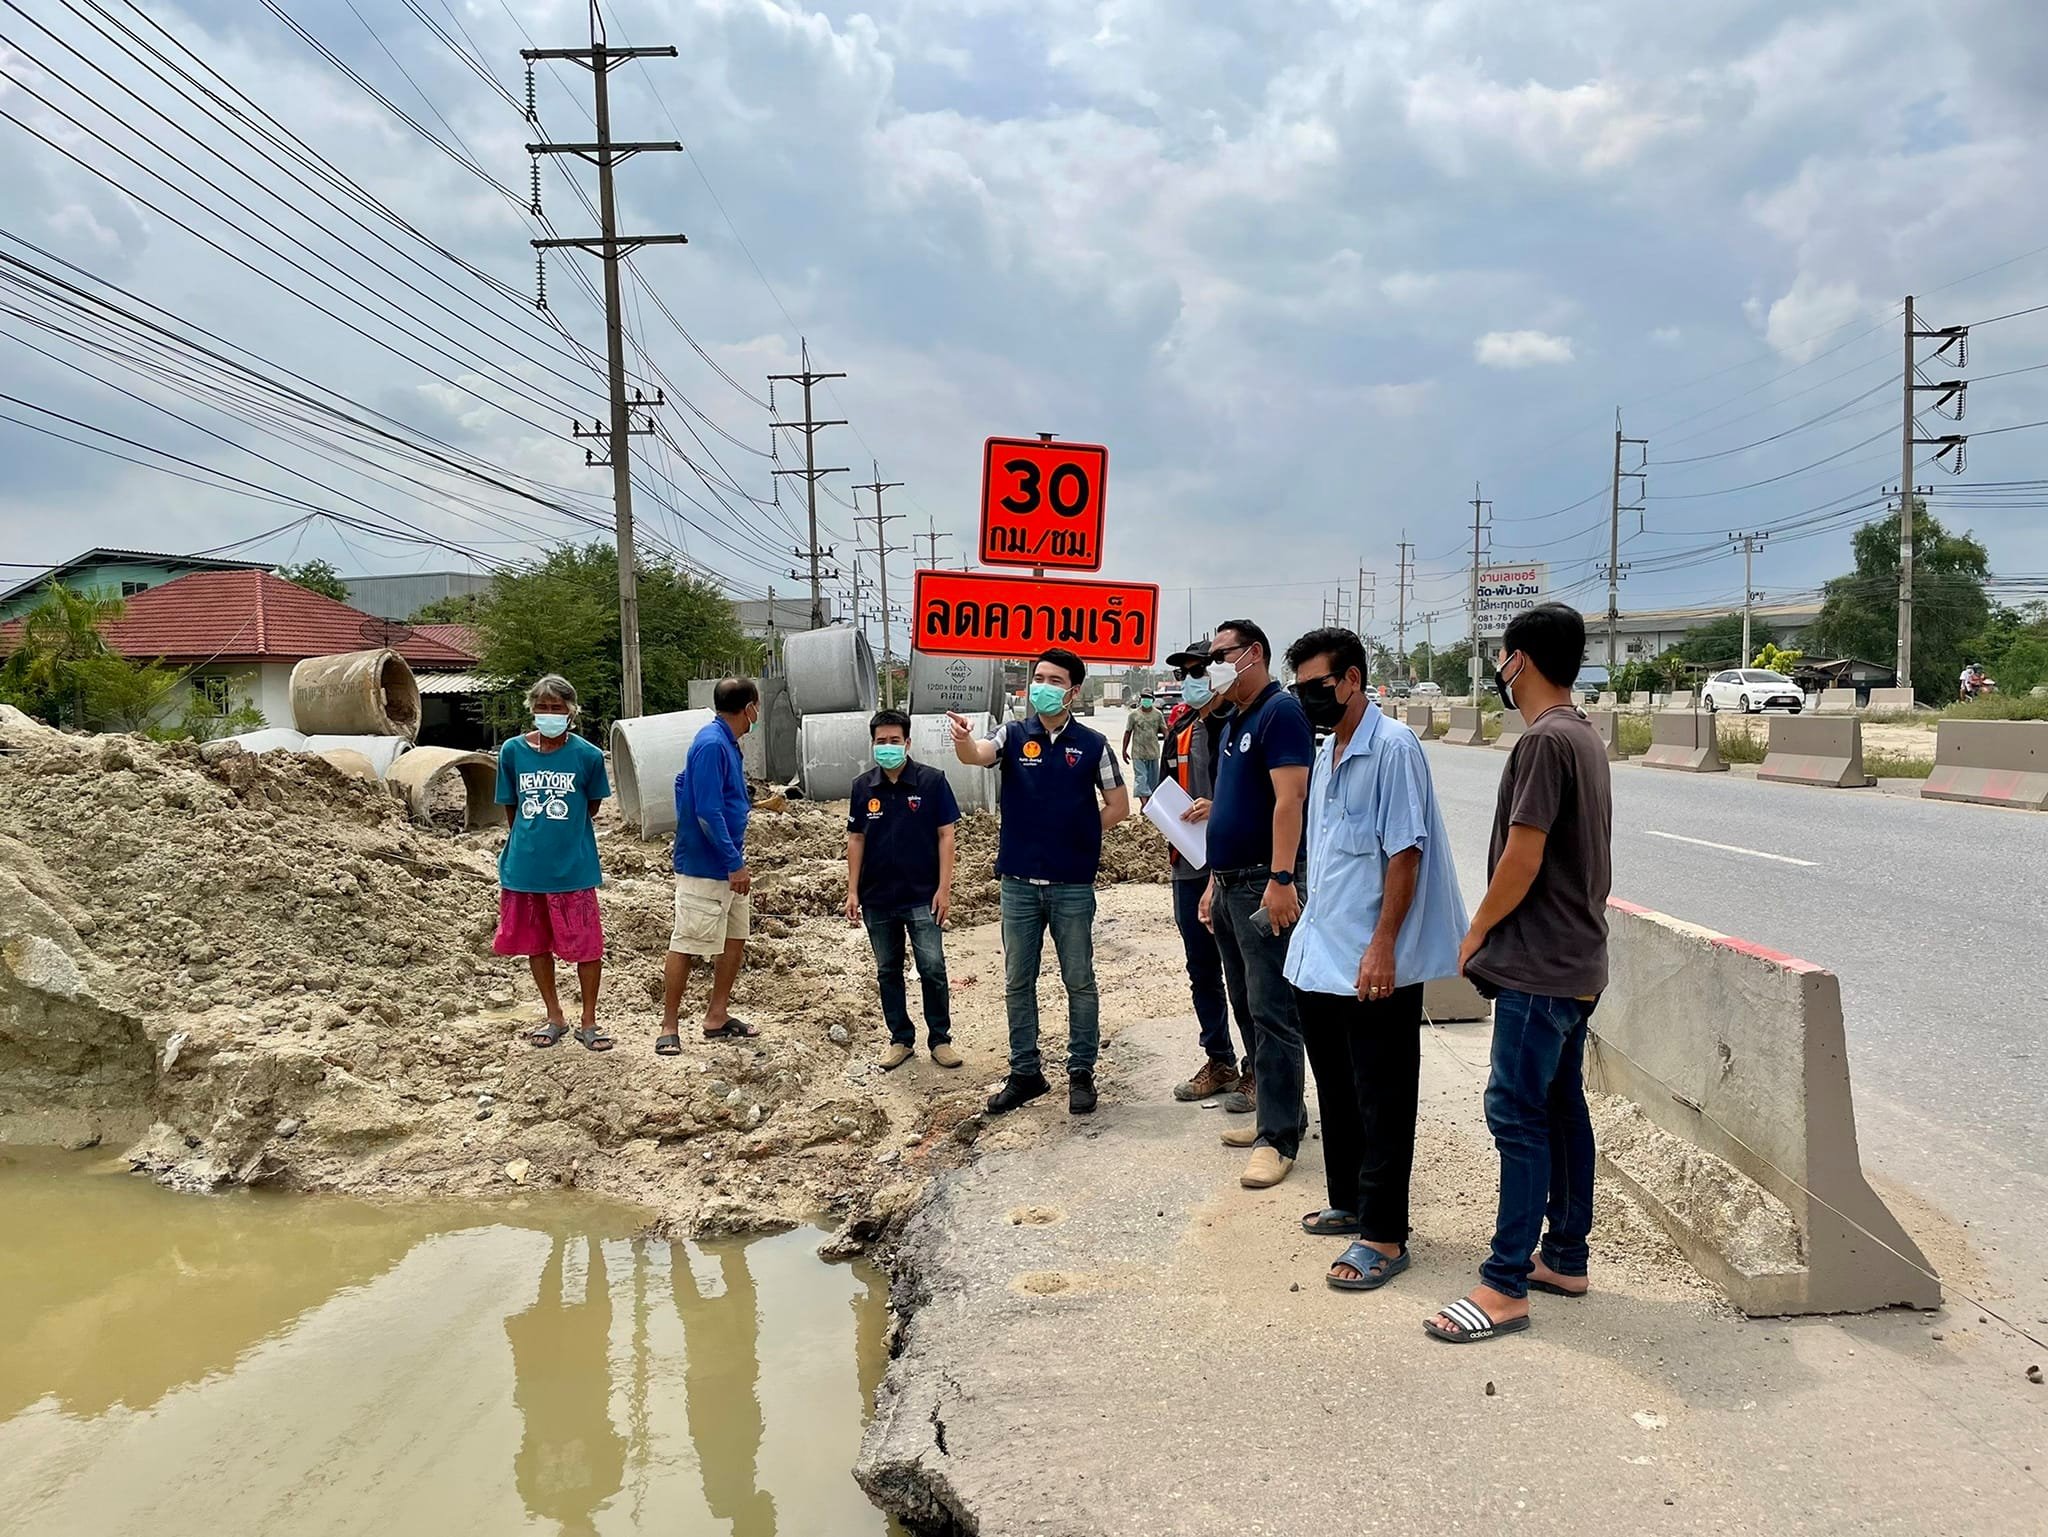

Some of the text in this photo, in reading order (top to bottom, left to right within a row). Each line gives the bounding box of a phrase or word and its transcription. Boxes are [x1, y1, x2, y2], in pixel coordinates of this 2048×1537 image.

[1000, 458, 1090, 518] 30
[990, 525, 1092, 559] กม./ชม.
[926, 596, 1145, 646] ลดความเร็ว
[1478, 614, 1514, 622] 081-761
[1470, 1330, 1494, 1338] adidas
